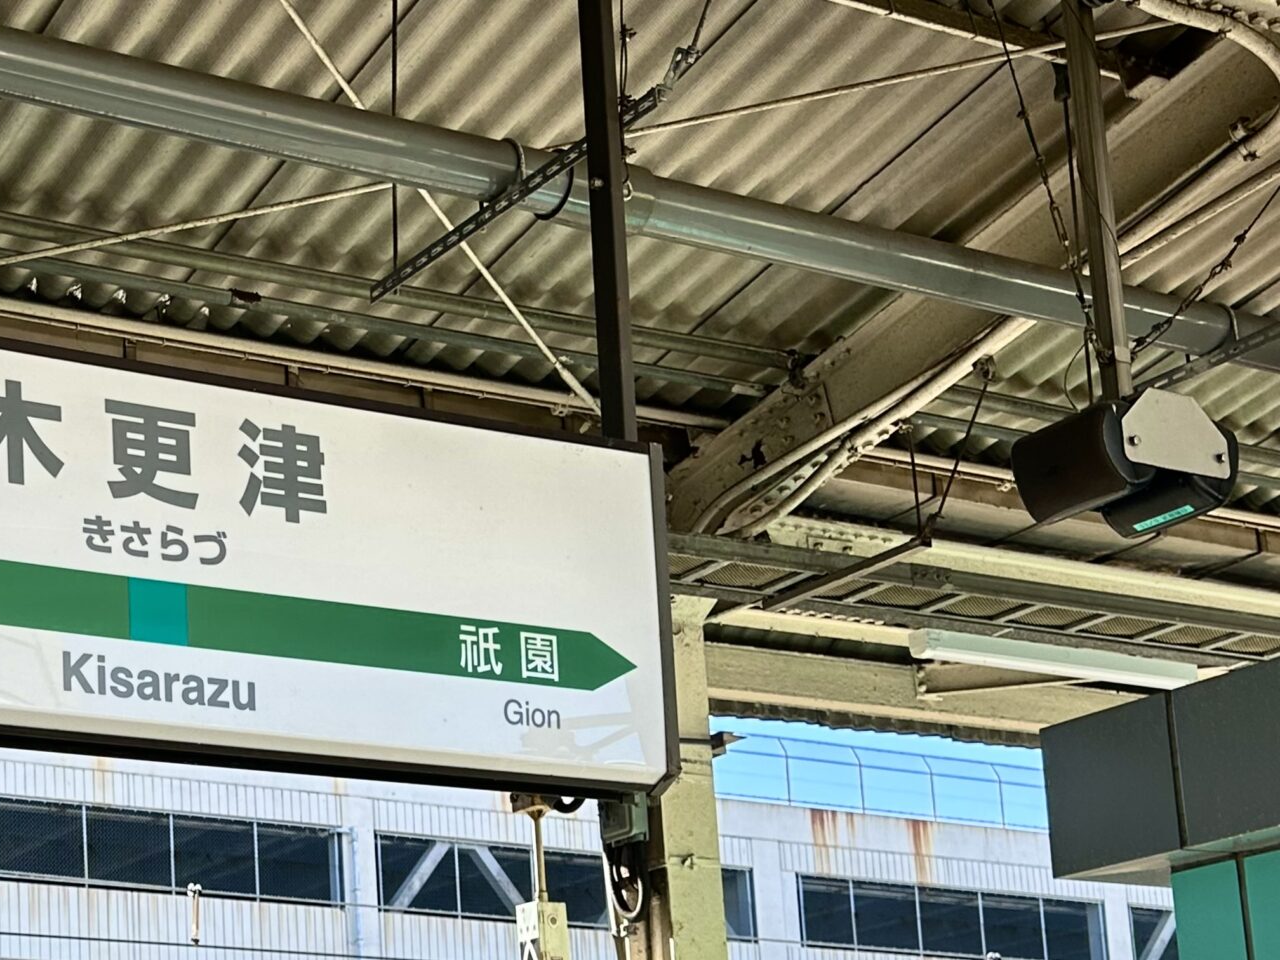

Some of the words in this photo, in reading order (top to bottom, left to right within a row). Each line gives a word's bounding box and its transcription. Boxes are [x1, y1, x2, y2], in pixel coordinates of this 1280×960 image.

[82, 515, 228, 566] きさらづ
[459, 624, 560, 682] 祇園
[61, 651, 258, 712] Kisarazu
[504, 700, 562, 730] Gion
